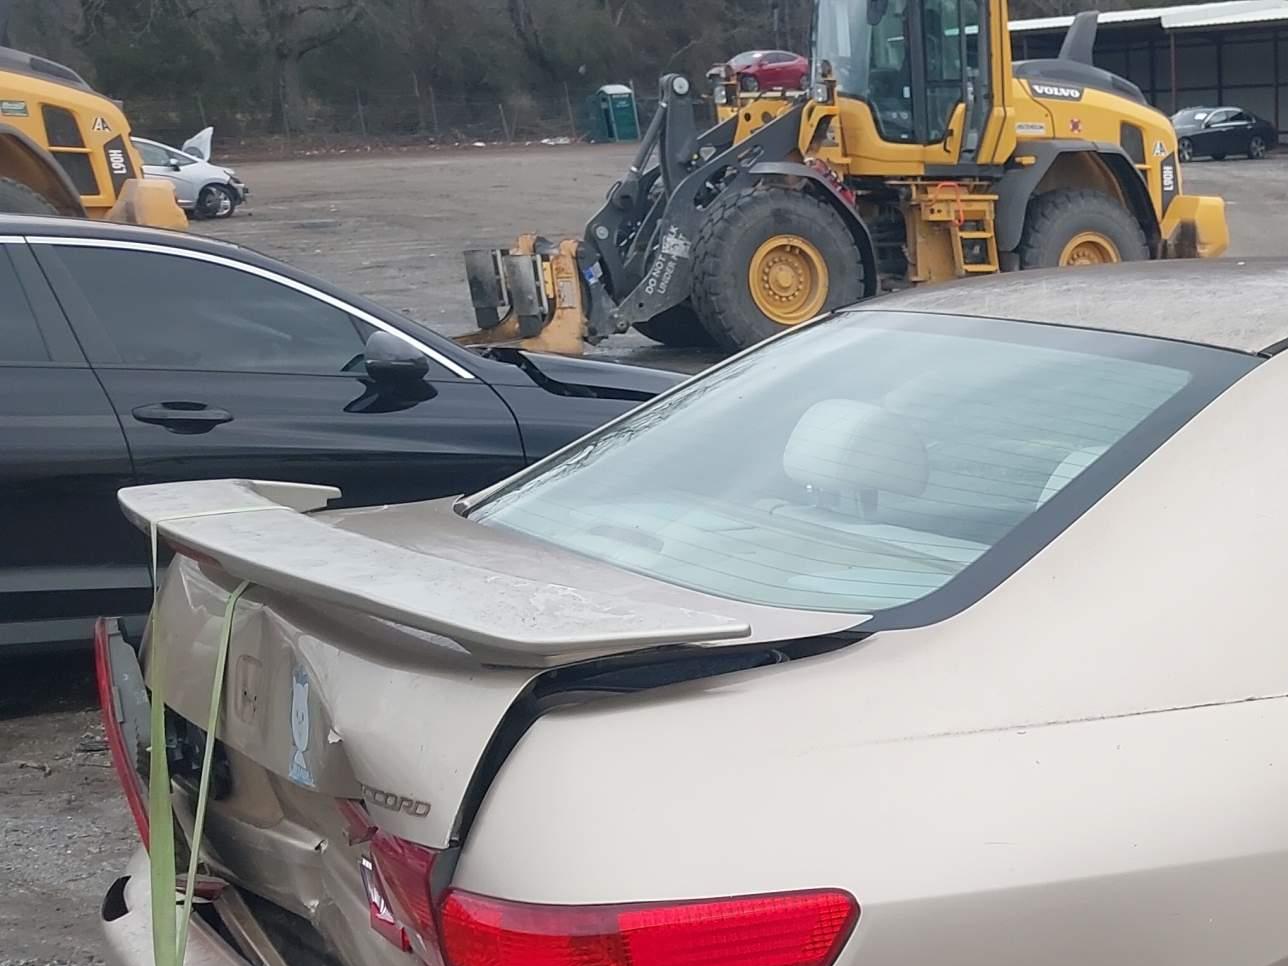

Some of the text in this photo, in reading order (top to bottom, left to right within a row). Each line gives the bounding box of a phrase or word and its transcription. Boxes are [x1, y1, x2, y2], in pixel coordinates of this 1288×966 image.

[1032, 85, 1081, 98] VOLVO
[107, 149, 128, 175] L90H
[1162, 166, 1174, 191] L90H
[645, 278, 657, 295] DO
[652, 254, 666, 278] NOT
[657, 261, 677, 294] UNDER
[361, 783, 432, 818] CCORD
